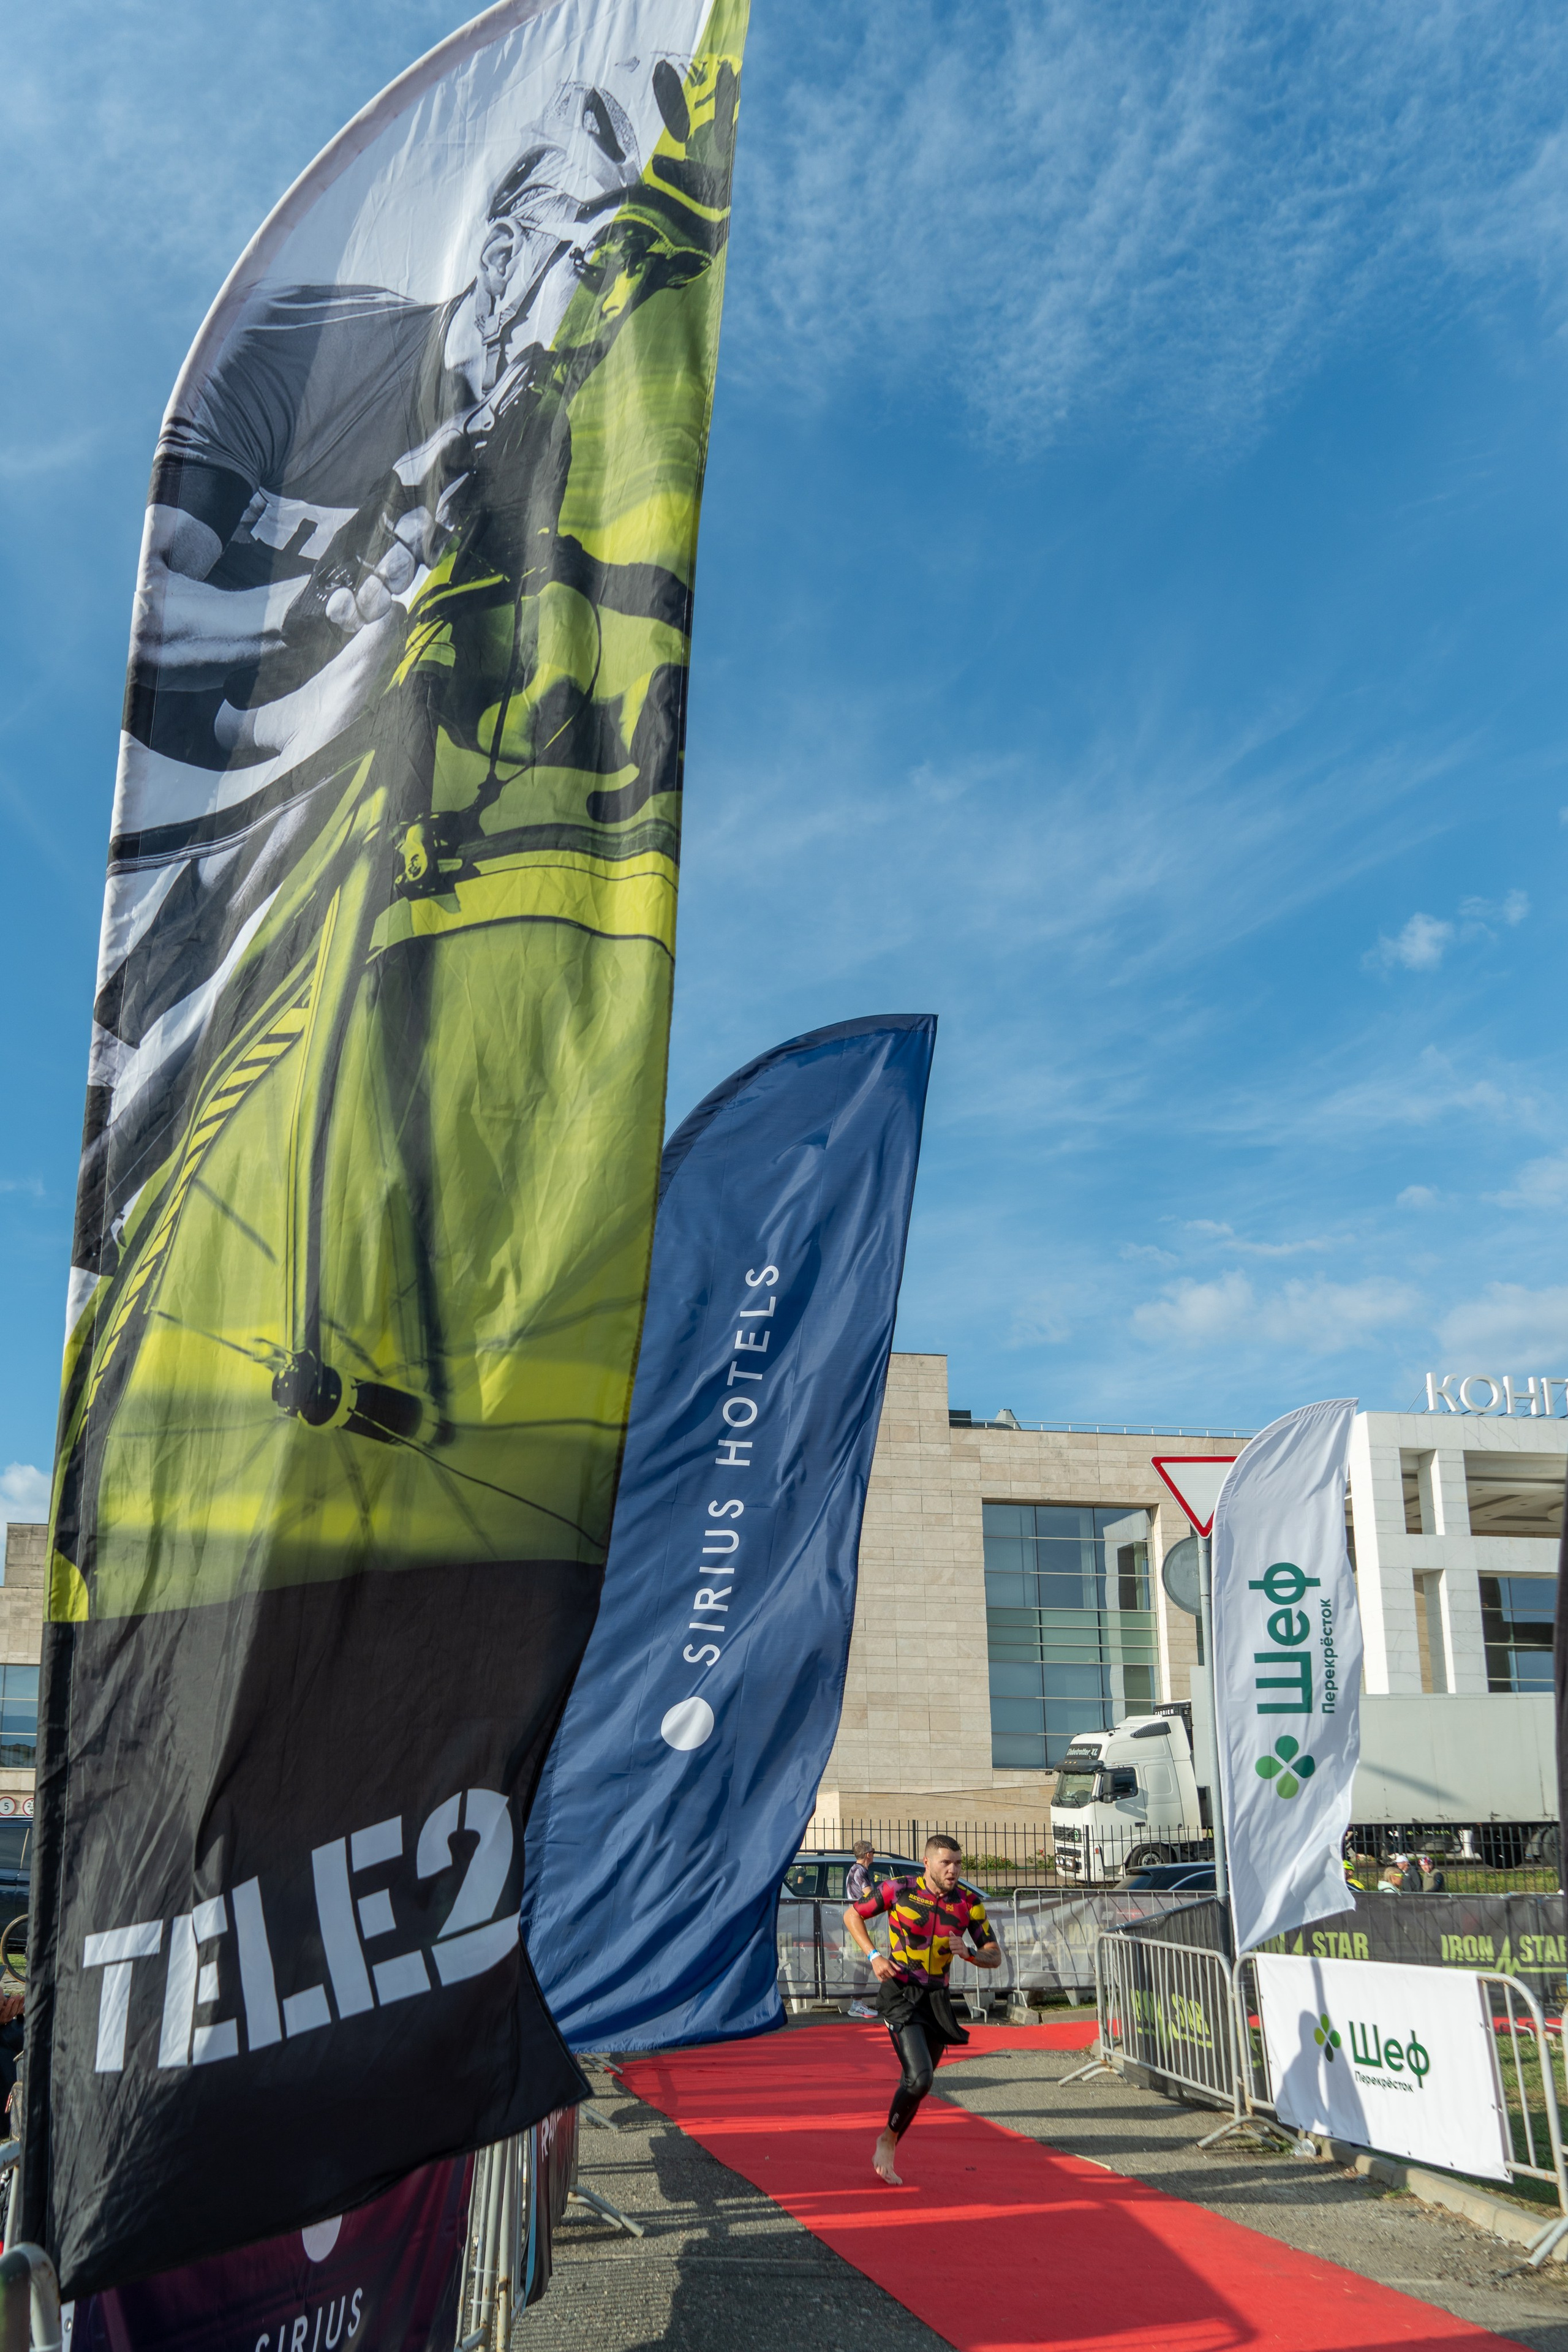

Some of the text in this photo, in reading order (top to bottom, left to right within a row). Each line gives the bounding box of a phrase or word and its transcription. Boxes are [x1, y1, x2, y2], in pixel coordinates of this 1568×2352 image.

[1426, 1372, 1568, 1415] КОНГ
[683, 1265, 779, 1667] SIRIUS HOTELS
[1248, 1562, 1321, 1714] Шеф
[1320, 1598, 1338, 1714] Перекрёсток
[908, 1893, 934, 1905] RECORD
[83, 1789, 519, 2073] TELE2
[1312, 1931, 1369, 1960] STAR
[1440, 1934, 1494, 1962] IRON
[1348, 2021, 1430, 2089] Шеф
[1355, 2070, 1414, 2093] Перекрёсток
